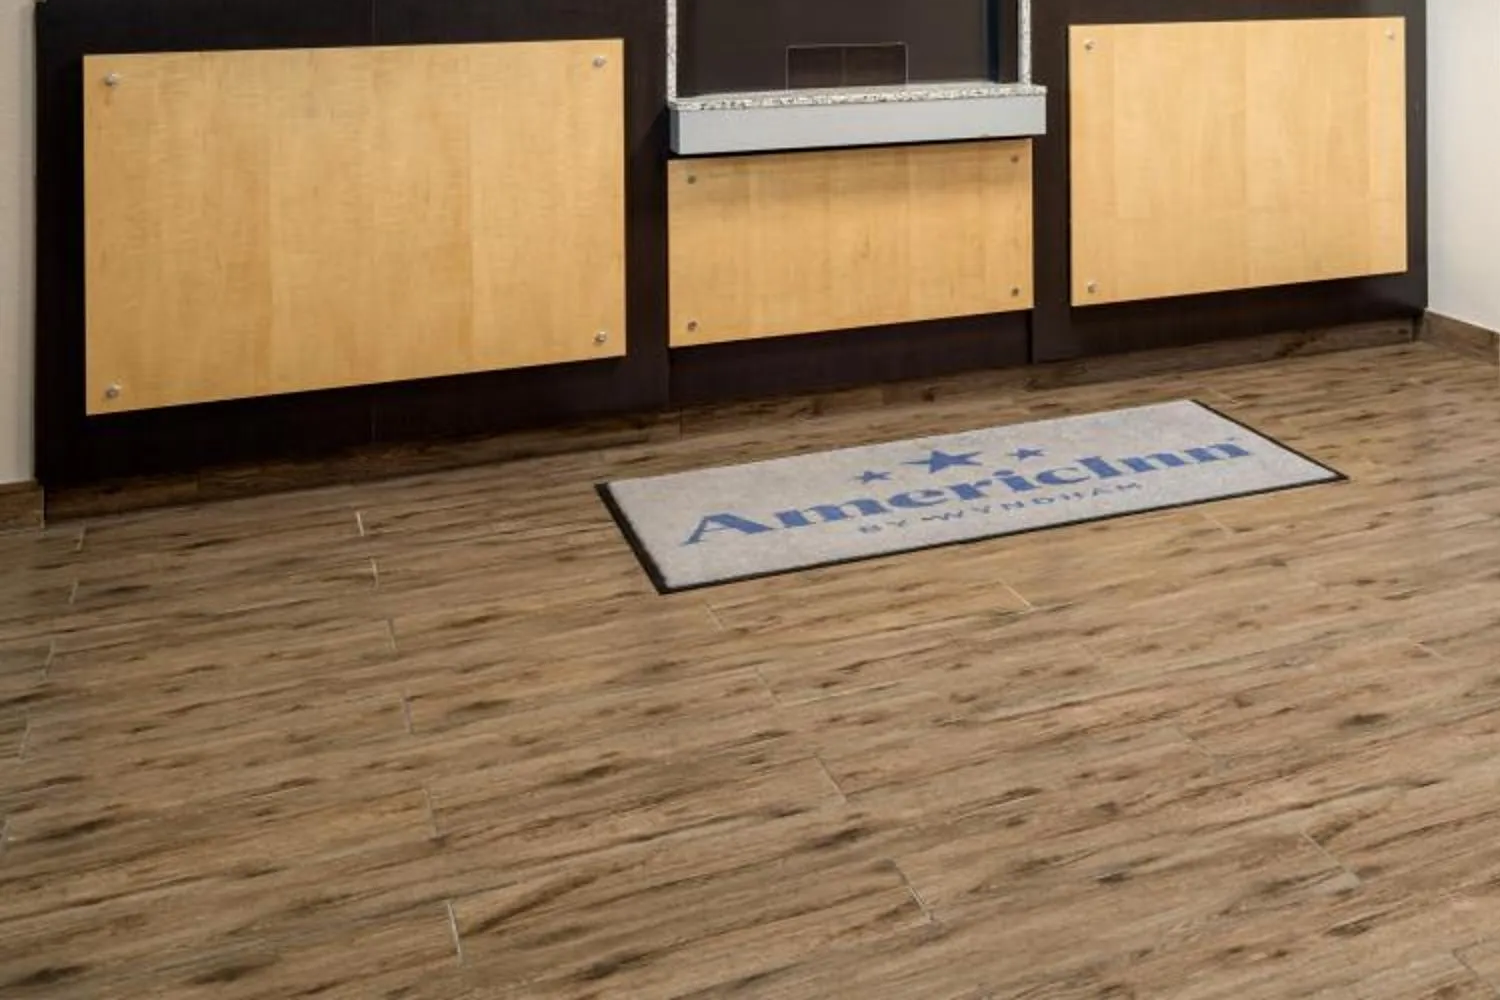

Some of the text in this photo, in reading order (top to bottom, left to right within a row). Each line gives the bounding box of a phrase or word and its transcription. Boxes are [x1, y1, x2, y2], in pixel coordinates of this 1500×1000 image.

[680, 443, 1253, 546] AmericInn
[858, 482, 1143, 534] BY WYNDHAM
